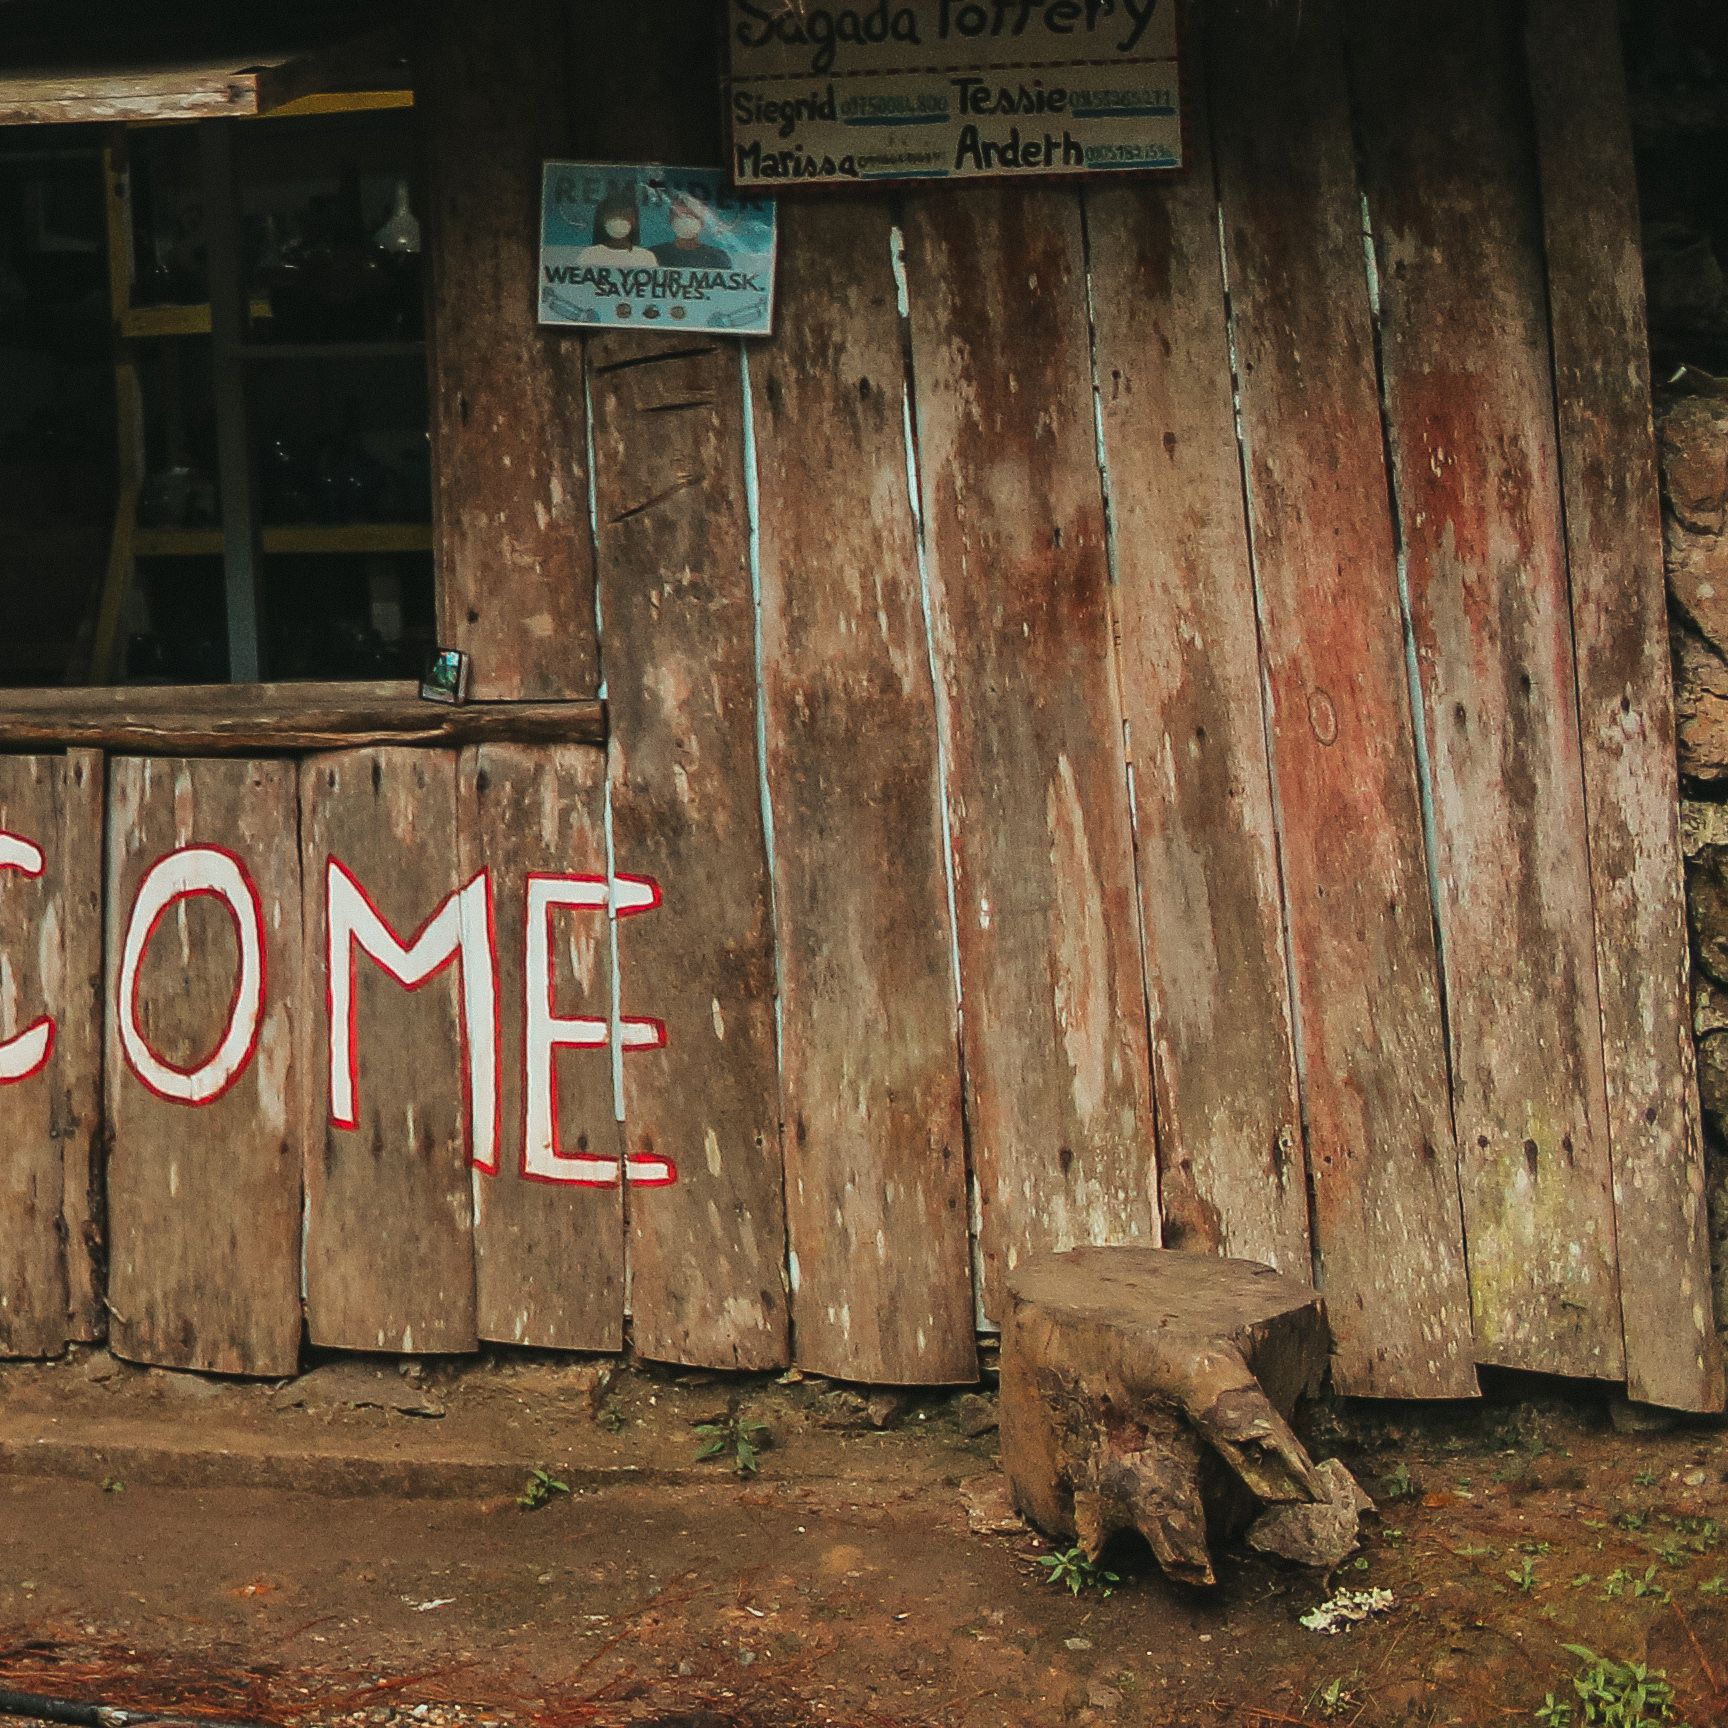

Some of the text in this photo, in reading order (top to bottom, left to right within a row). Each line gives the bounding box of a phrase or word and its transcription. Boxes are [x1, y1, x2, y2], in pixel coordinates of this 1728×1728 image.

[733, 82, 839, 137] Siegrid
[951, 77, 1067, 116] Tessie
[735, 140, 861, 178] Marissa
[955, 124, 1084, 169] Ardeth
[545, 266, 765, 291] WEAR YOUR MASK.
[594, 281, 648, 298] SAVE
